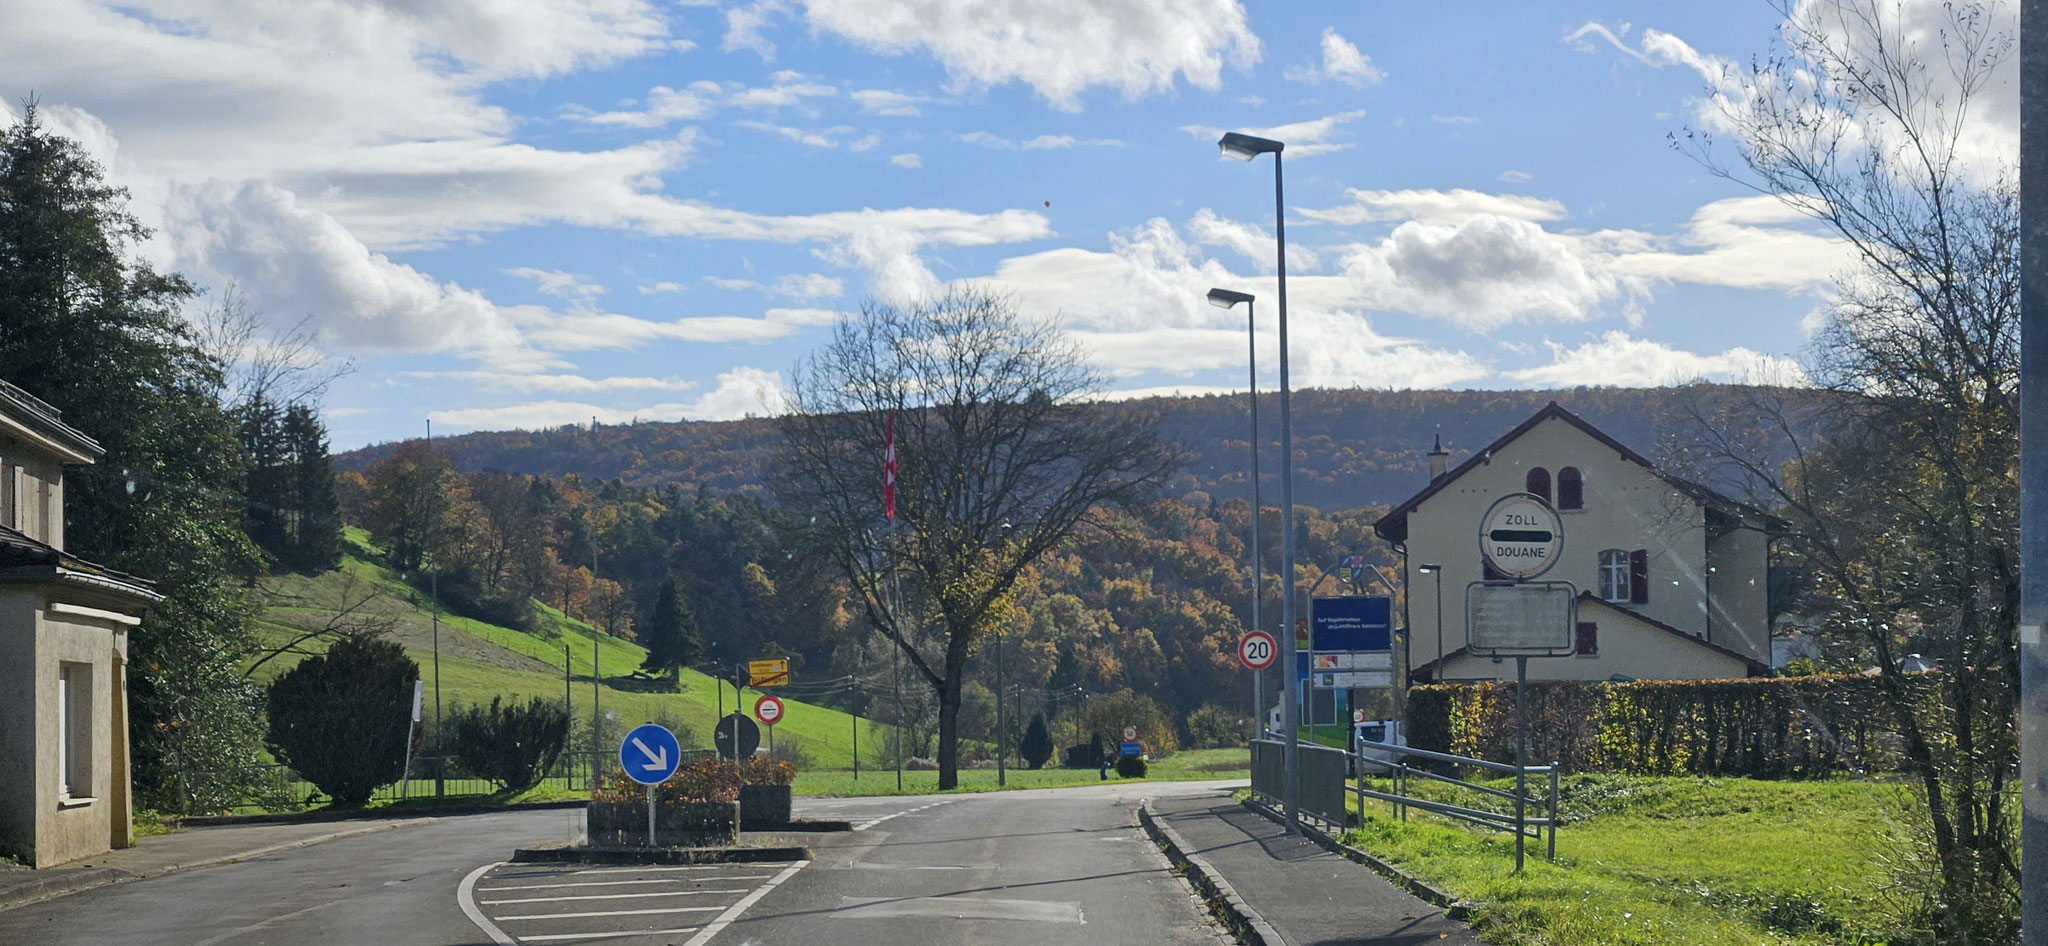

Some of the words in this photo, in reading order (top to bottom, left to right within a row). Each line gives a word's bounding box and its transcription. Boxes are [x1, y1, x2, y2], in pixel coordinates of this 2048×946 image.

[1505, 514, 1538, 526] ZOLL
[1496, 546, 1546, 558] DOUANE
[1247, 641, 1269, 659] 20
